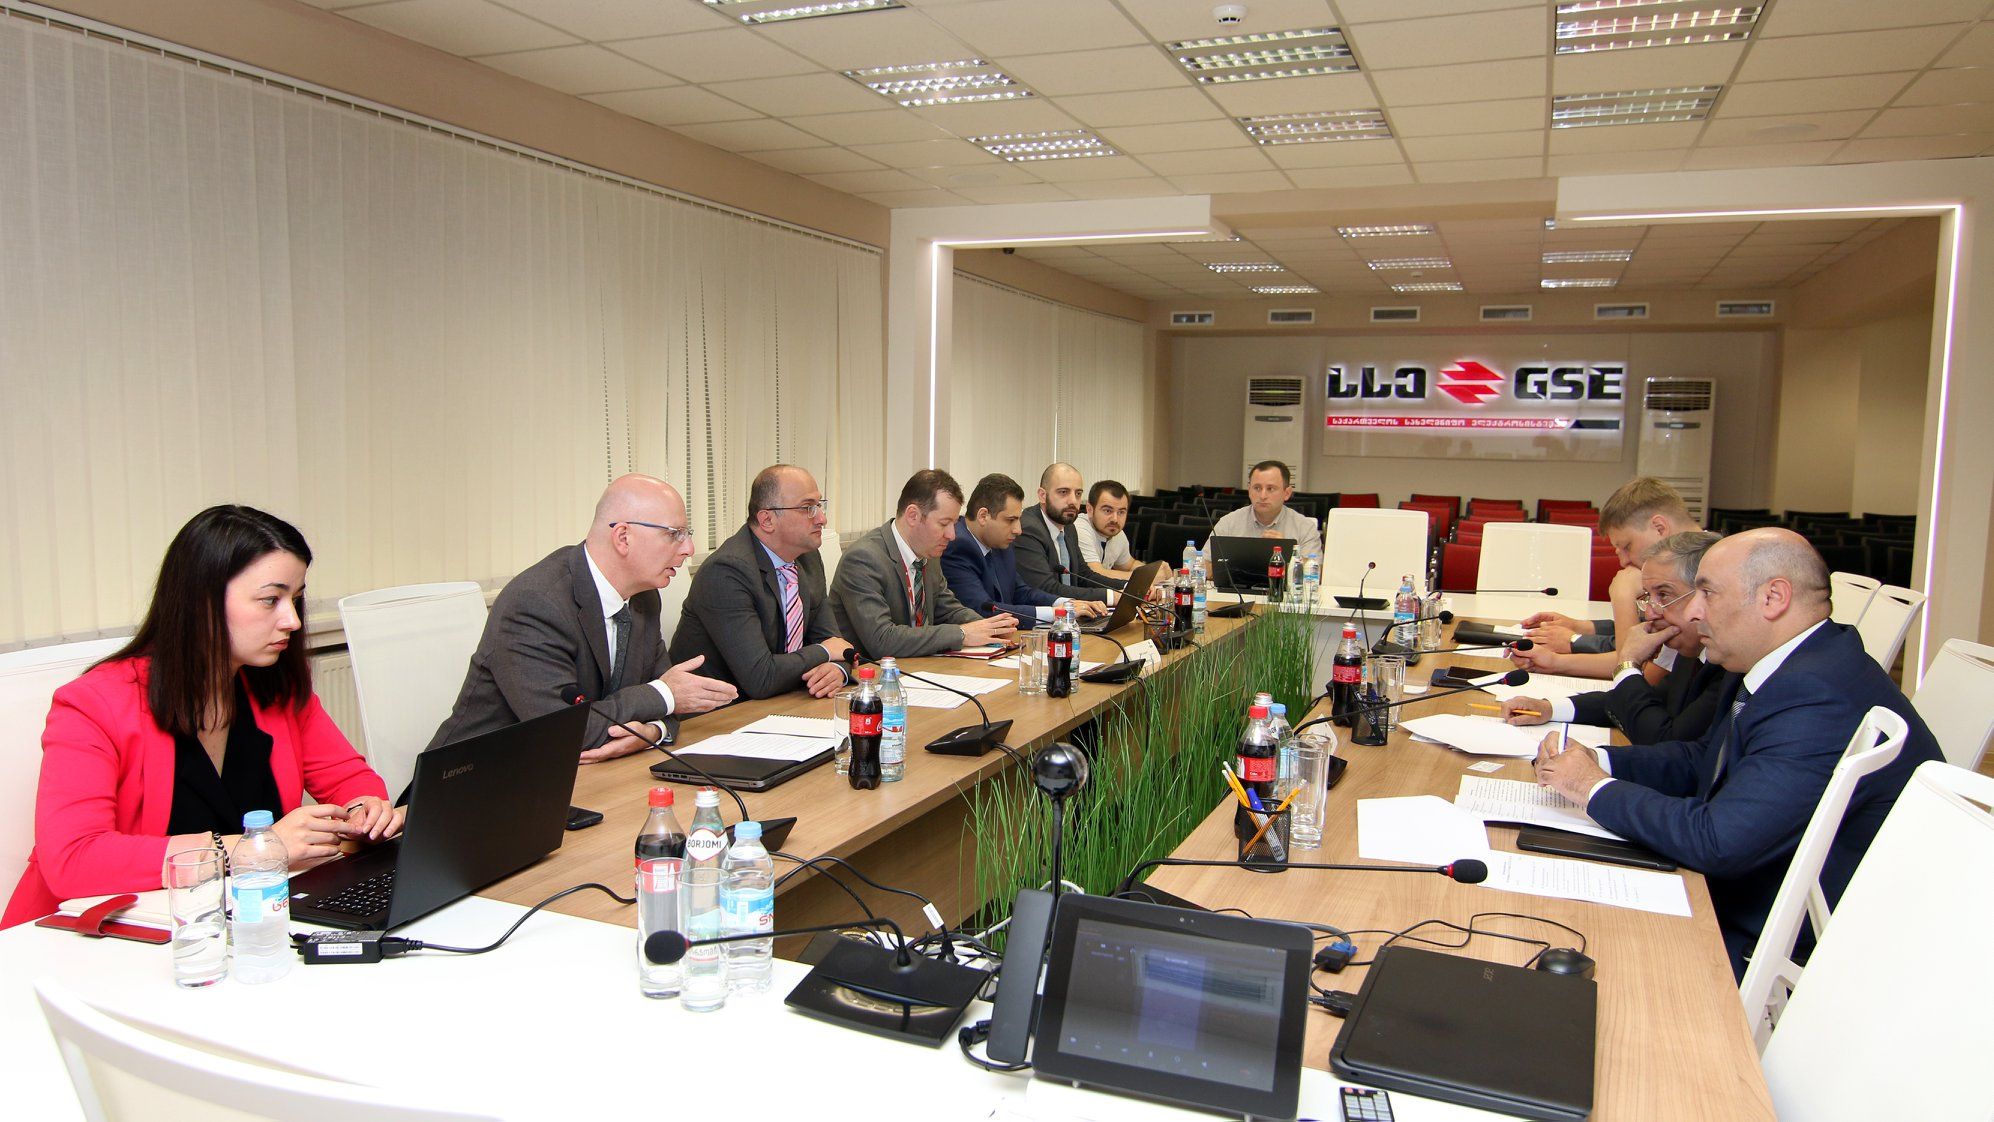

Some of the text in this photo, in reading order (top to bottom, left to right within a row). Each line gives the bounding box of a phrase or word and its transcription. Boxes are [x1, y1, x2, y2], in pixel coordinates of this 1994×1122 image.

[1513, 366, 1624, 400] GSE
[443, 763, 474, 779] Lenovo
[687, 839, 722, 849] BORJOMI
